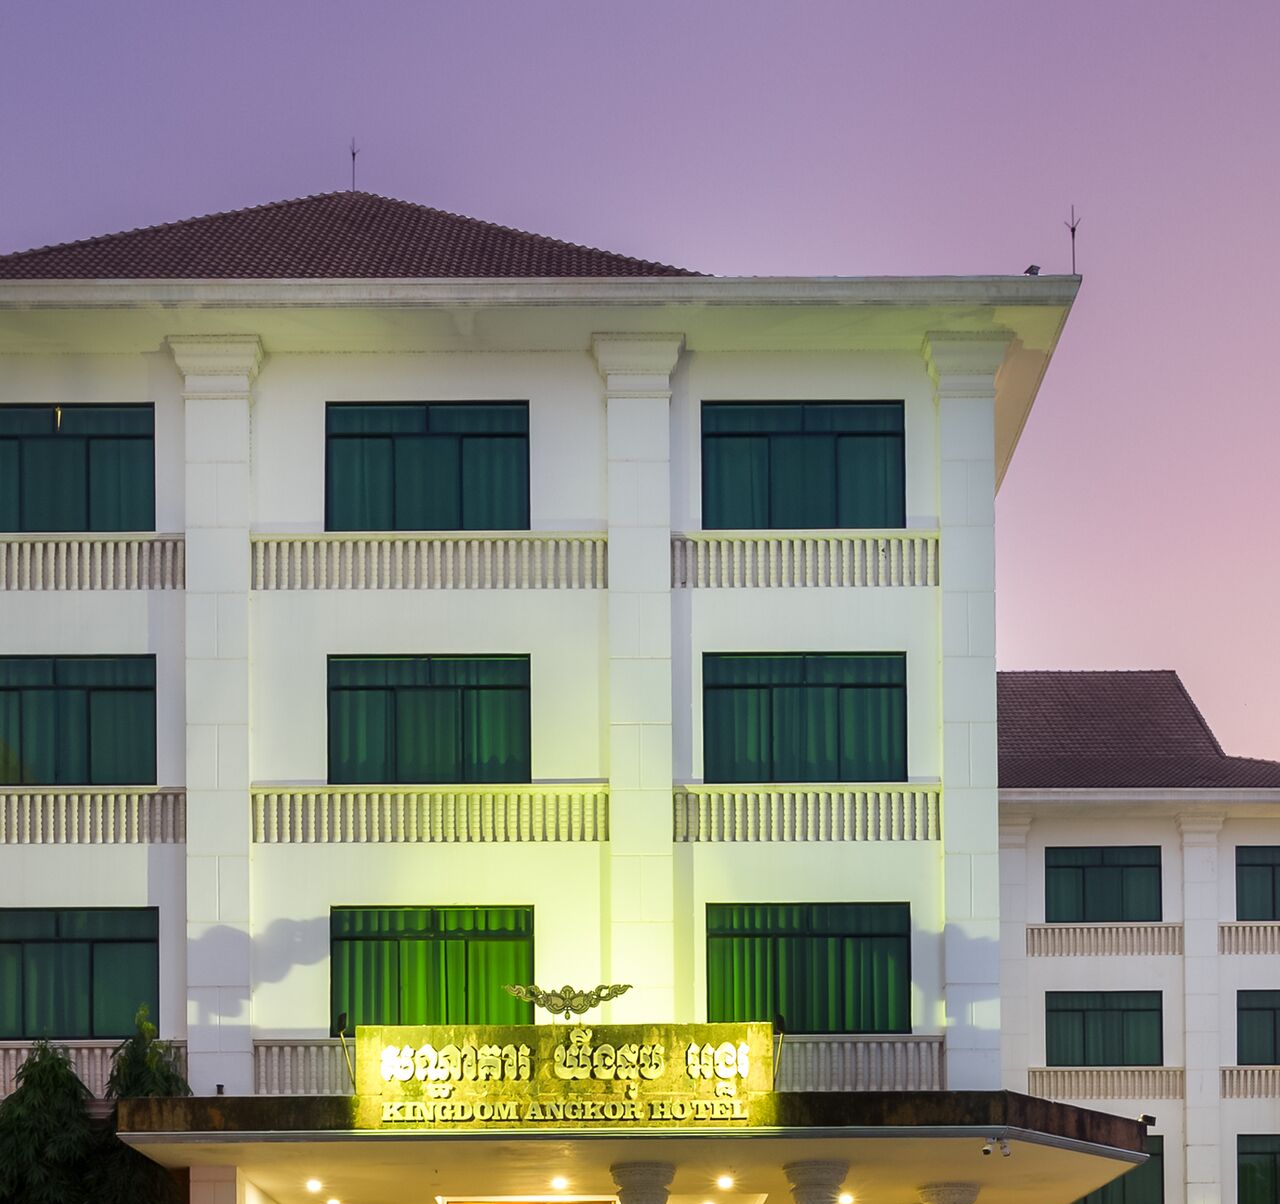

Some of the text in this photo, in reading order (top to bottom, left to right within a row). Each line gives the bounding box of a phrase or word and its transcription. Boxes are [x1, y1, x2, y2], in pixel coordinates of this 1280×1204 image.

[686, 1041, 750, 1097] អង្គរ
[381, 1101, 749, 1121] KINGDOM ANGKOR HOTEL
